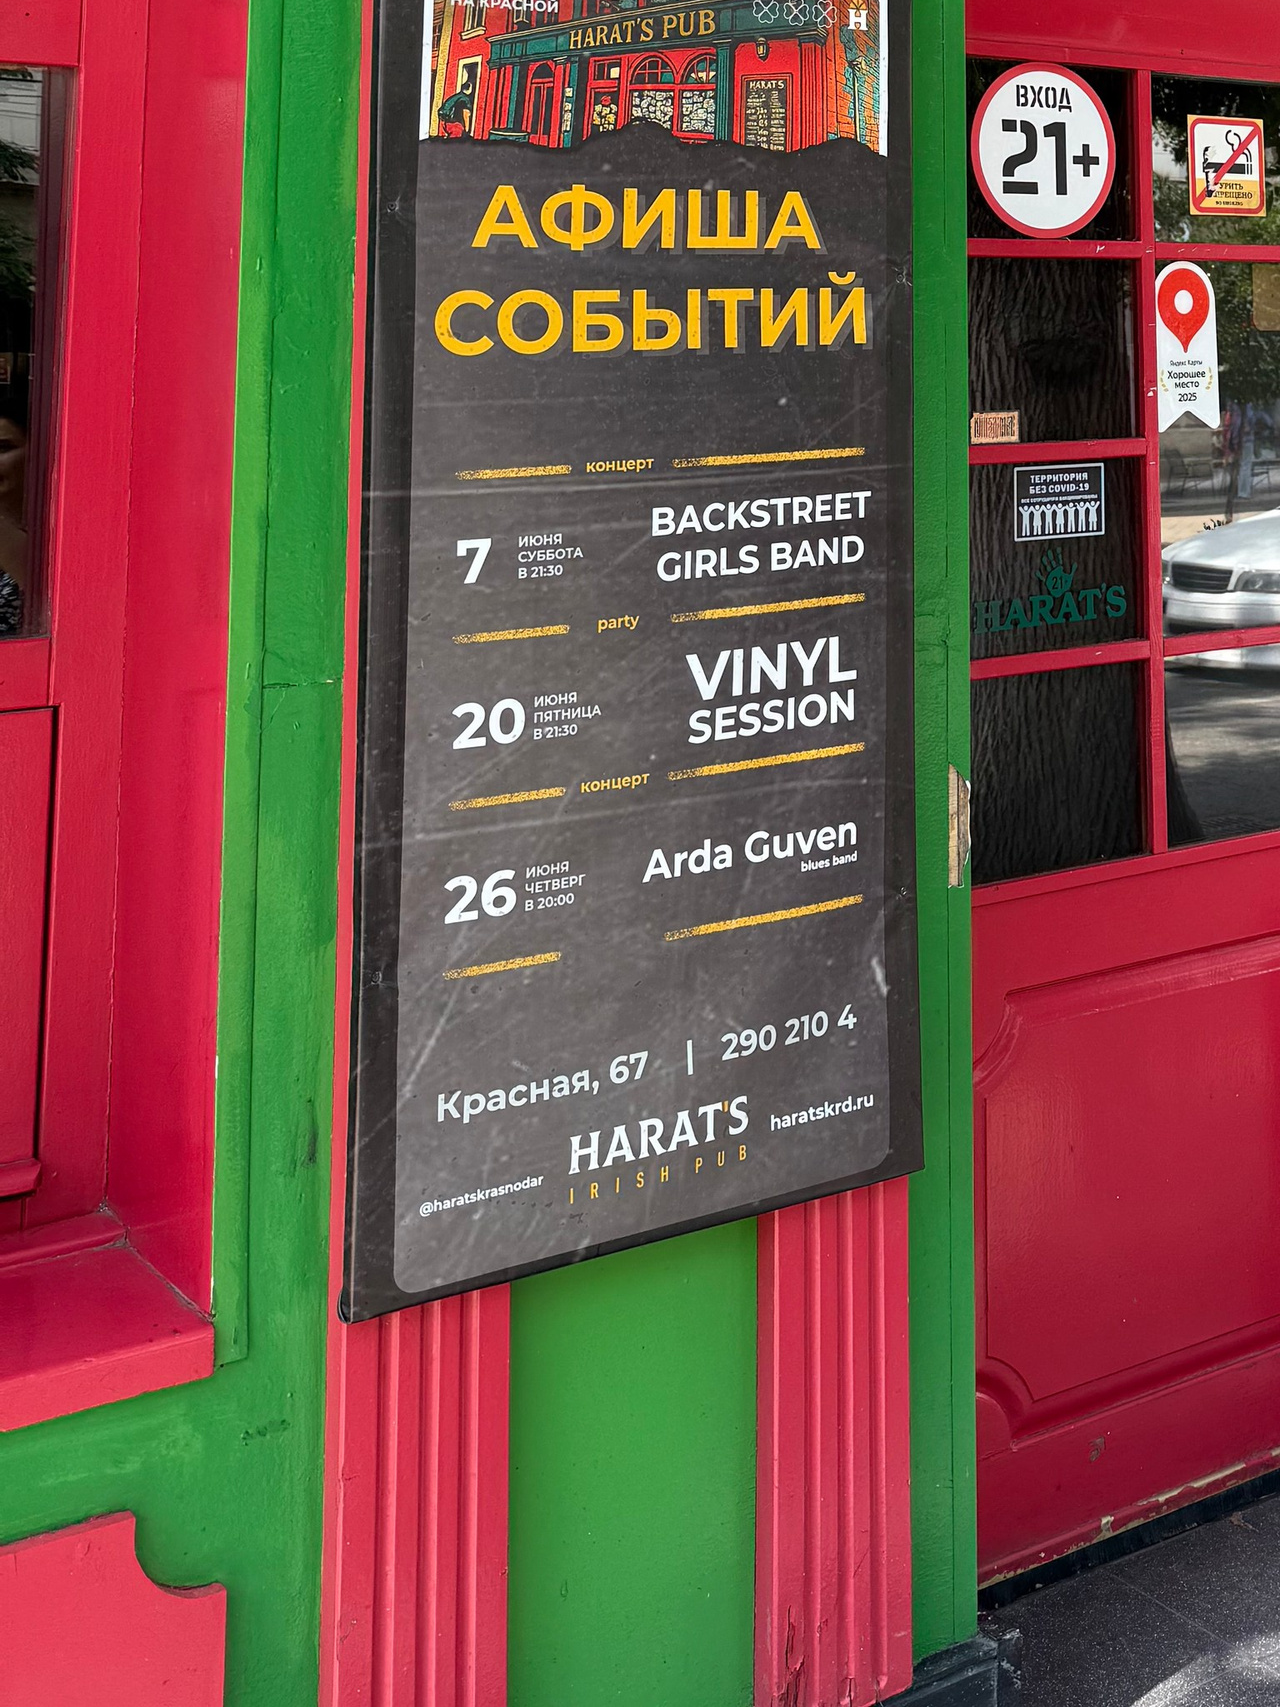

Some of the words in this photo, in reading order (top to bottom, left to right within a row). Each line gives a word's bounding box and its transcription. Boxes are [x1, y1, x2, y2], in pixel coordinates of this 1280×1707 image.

[568, 15, 655, 51] HARAT'S
[661, 7, 718, 39] PUB
[1015, 84, 1072, 113] ВХОД
[1001, 118, 1100, 196] 21+
[1218, 182, 1244, 191] УРИТЬ
[471, 184, 822, 252] АФИША
[434, 271, 868, 357] СОБЫТИЙ
[1167, 370, 1206, 380] Хорошее
[1187, 359, 1203, 367] Карты
[1174, 381, 1200, 389] место
[1178, 392, 1198, 402] 2025
[585, 457, 655, 476] концерт
[1030, 472, 1088, 484] ТЕРРИТОРИЯ
[1029, 485, 1047, 494] БЕЗ
[1048, 482, 1090, 493] COVID-19
[650, 490, 872, 538] BACKSTREET
[517, 533, 564, 548] ИЮНЯ
[455, 537, 493, 586] 7
[517, 547, 584, 564] СУББОТА
[656, 544, 761, 583] GIRLS
[769, 534, 866, 573] BAND
[517, 567, 527, 580] В
[530, 564, 564, 579] 21:30
[974, 582, 1127, 635] HARAT'S
[597, 614, 640, 634] party
[685, 635, 858, 702] VINYL
[533, 691, 578, 709] ИЮНЯ
[451, 697, 527, 751] 20
[533, 705, 602, 724] ПЯТНИЦА
[687, 688, 856, 745] SESSION
[533, 727, 542, 740] В
[545, 723, 578, 739] 21:30
[580, 771, 650, 795] концерт
[642, 838, 733, 884] Arda
[744, 820, 858, 864] Guven
[800, 856, 831, 873] blues
[833, 851, 859, 869] band
[525, 860, 570, 879] ИЮНЯ
[525, 873, 586, 895] ЧЕТВЕРГ
[443, 869, 517, 925] 26
[524, 898, 534, 912] В
[537, 893, 575, 911] 20:00
[436, 1068, 600, 1124] Красная,
[609, 1051, 649, 1085] 67
[720, 1024, 777, 1061] 290
[784, 1013, 829, 1047] 210
[837, 1004, 858, 1030] 4
[770, 1093, 875, 1132] haratskrd.ru
[568, 1095, 750, 1176] HARAT'S
[569, 1165, 670, 1204] IRISH
[695, 1145, 748, 1174] PUB
[418, 1173, 545, 1217] @haratskrasnodar
